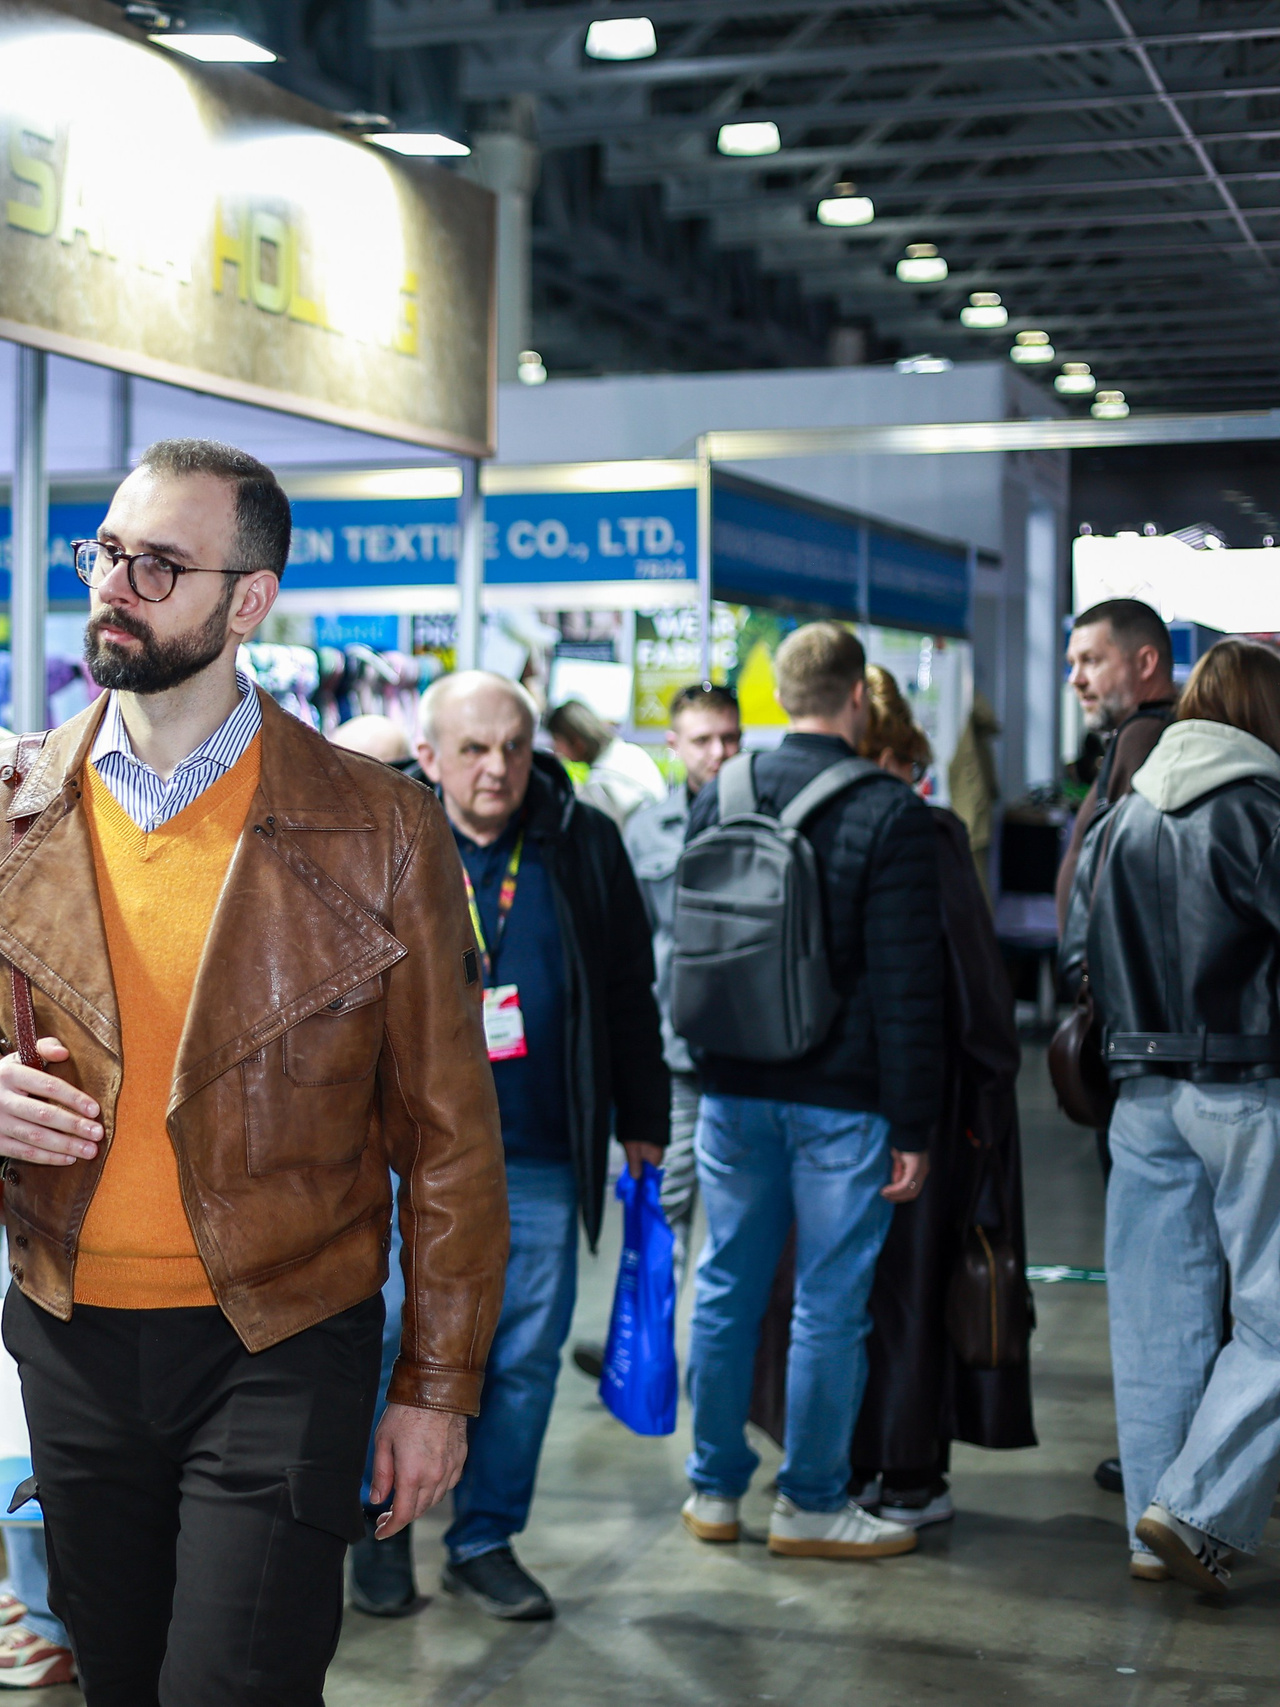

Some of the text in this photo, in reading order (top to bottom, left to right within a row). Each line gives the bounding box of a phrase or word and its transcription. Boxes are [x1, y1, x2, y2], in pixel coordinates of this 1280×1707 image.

[287, 526, 334, 565] EN
[507, 518, 590, 564] CO.,
[598, 516, 685, 557] LTD.
